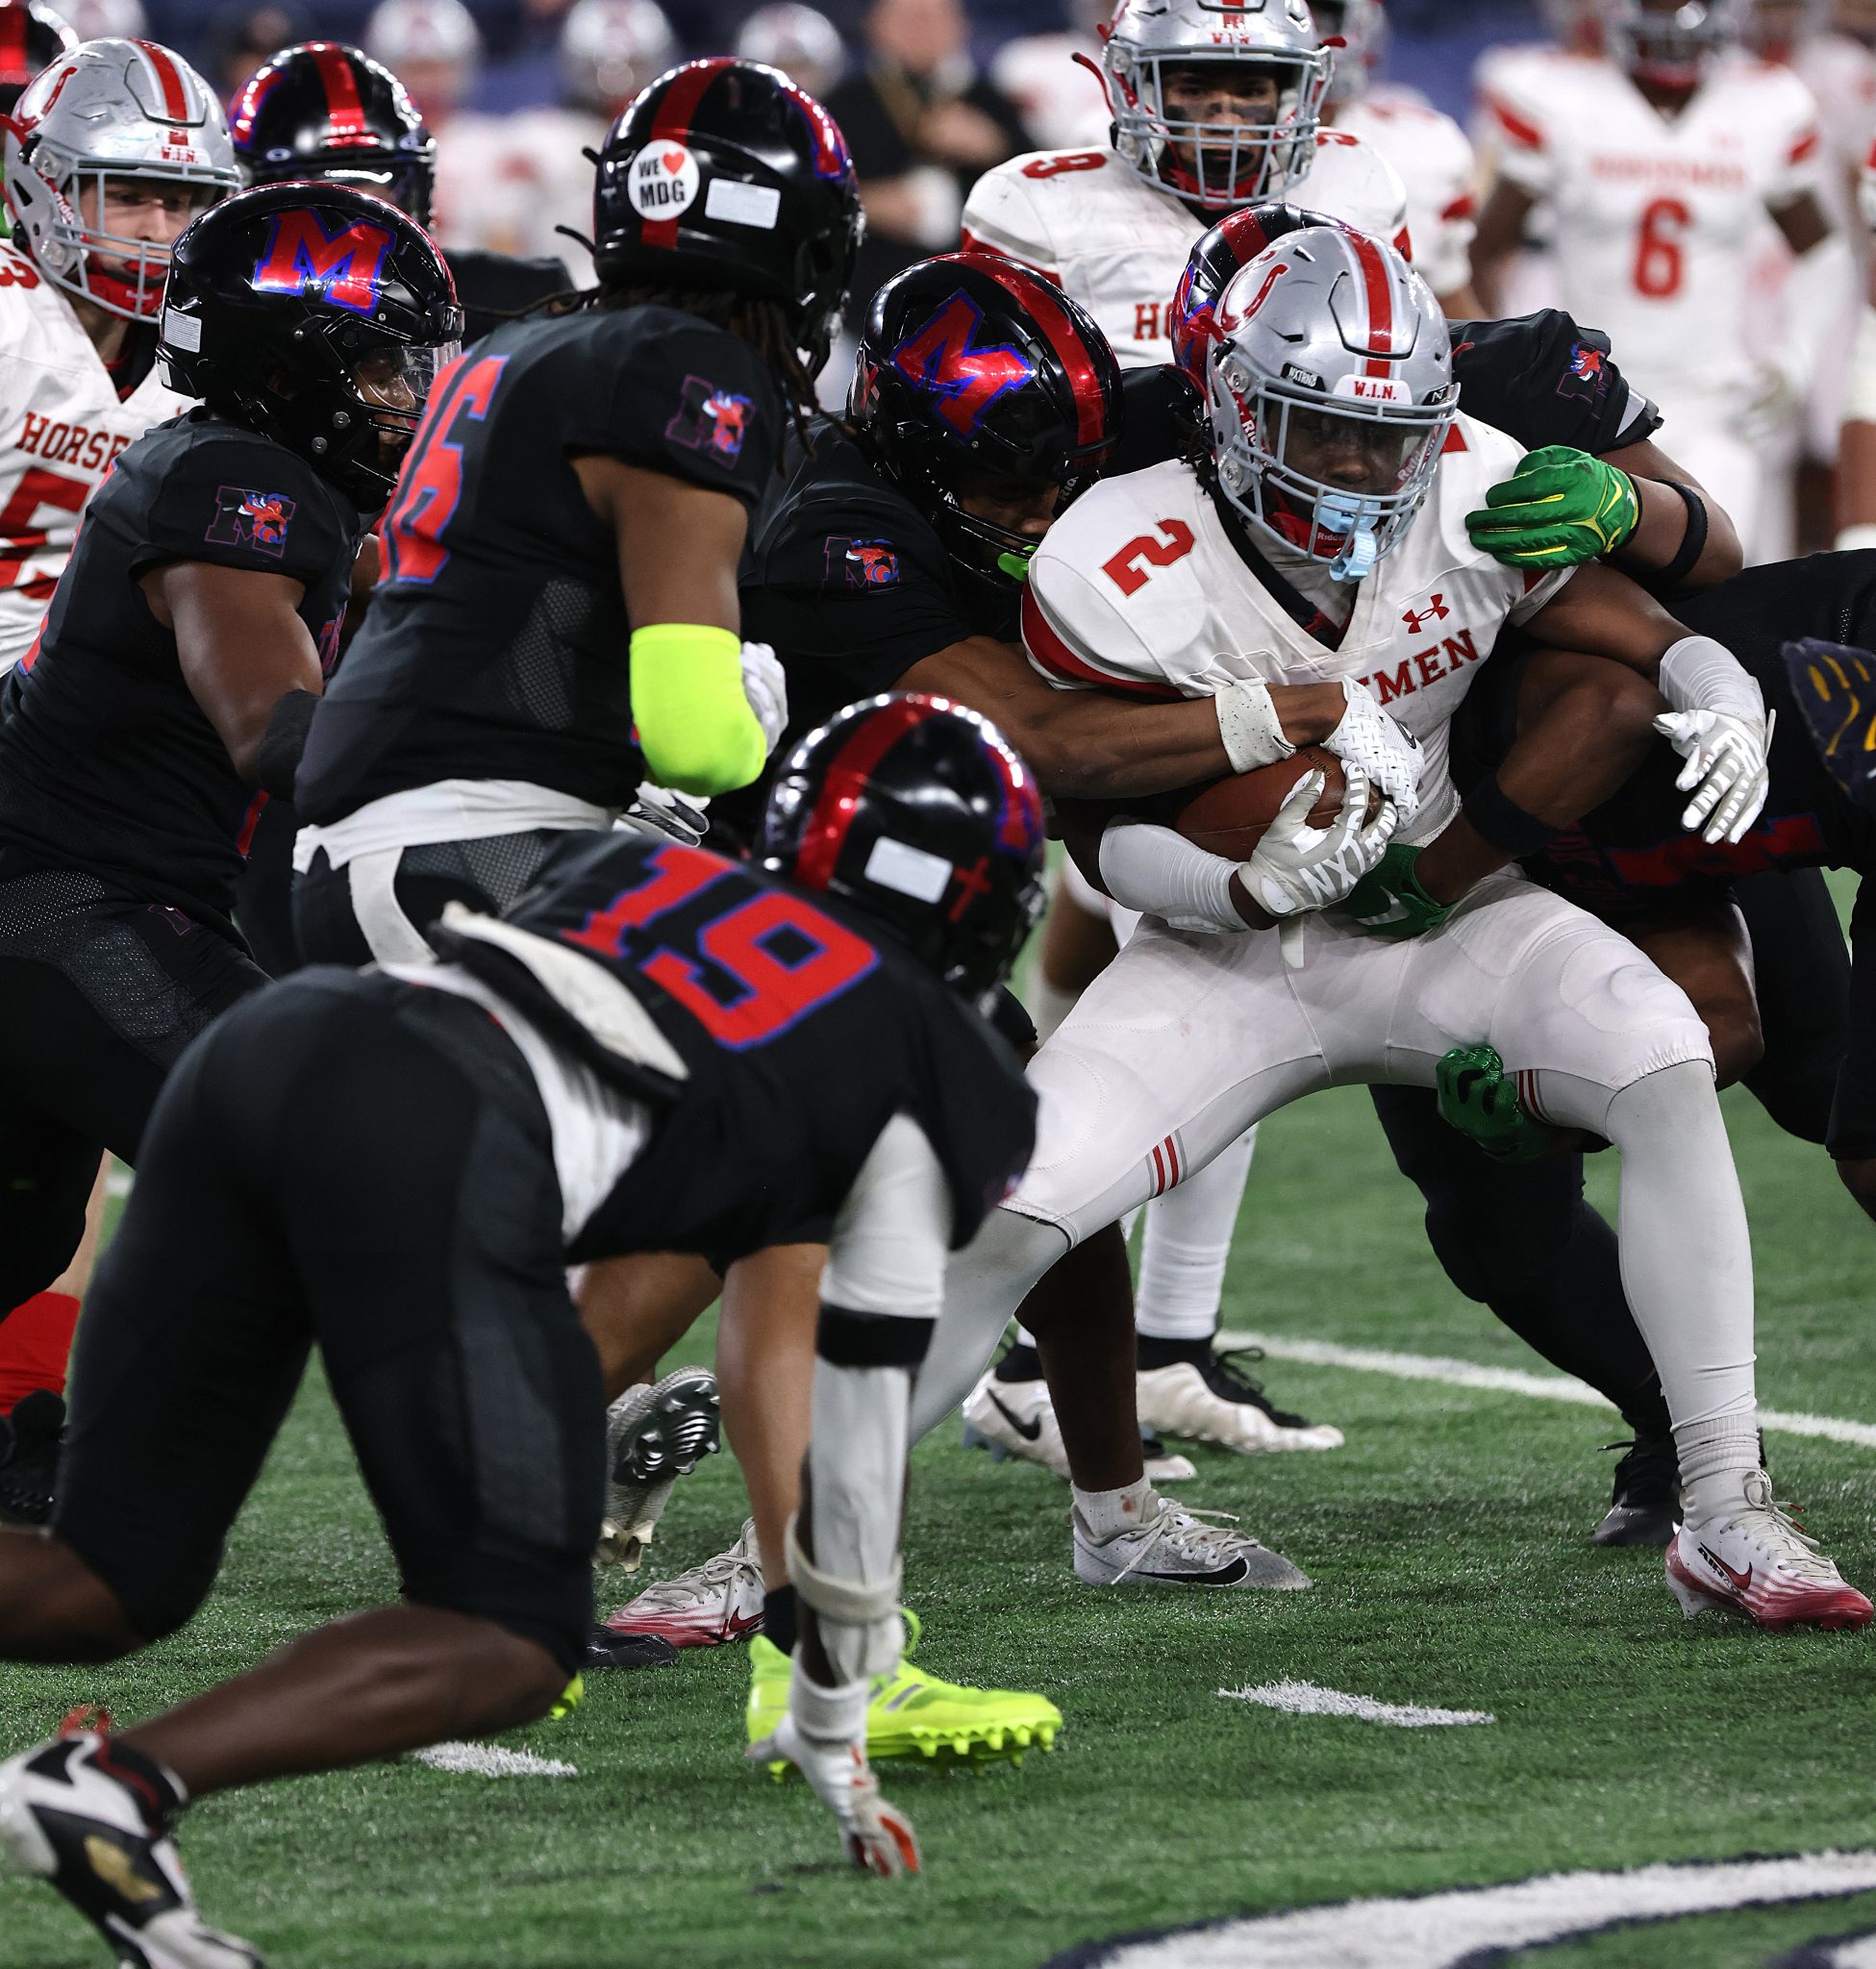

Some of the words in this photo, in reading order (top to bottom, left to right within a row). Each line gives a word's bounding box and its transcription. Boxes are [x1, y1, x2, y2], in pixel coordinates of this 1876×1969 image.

[638, 158, 660, 178] WE
[639, 180, 686, 209] MDG
[253, 206, 396, 318] M
[1634, 198, 1694, 302] 6
[888, 287, 1038, 446] M
[1354, 381, 1397, 400] W.I.N.
[1101, 517, 1196, 598] 2
[1365, 628, 1480, 707] MEN
[560, 843, 882, 1053] 19
